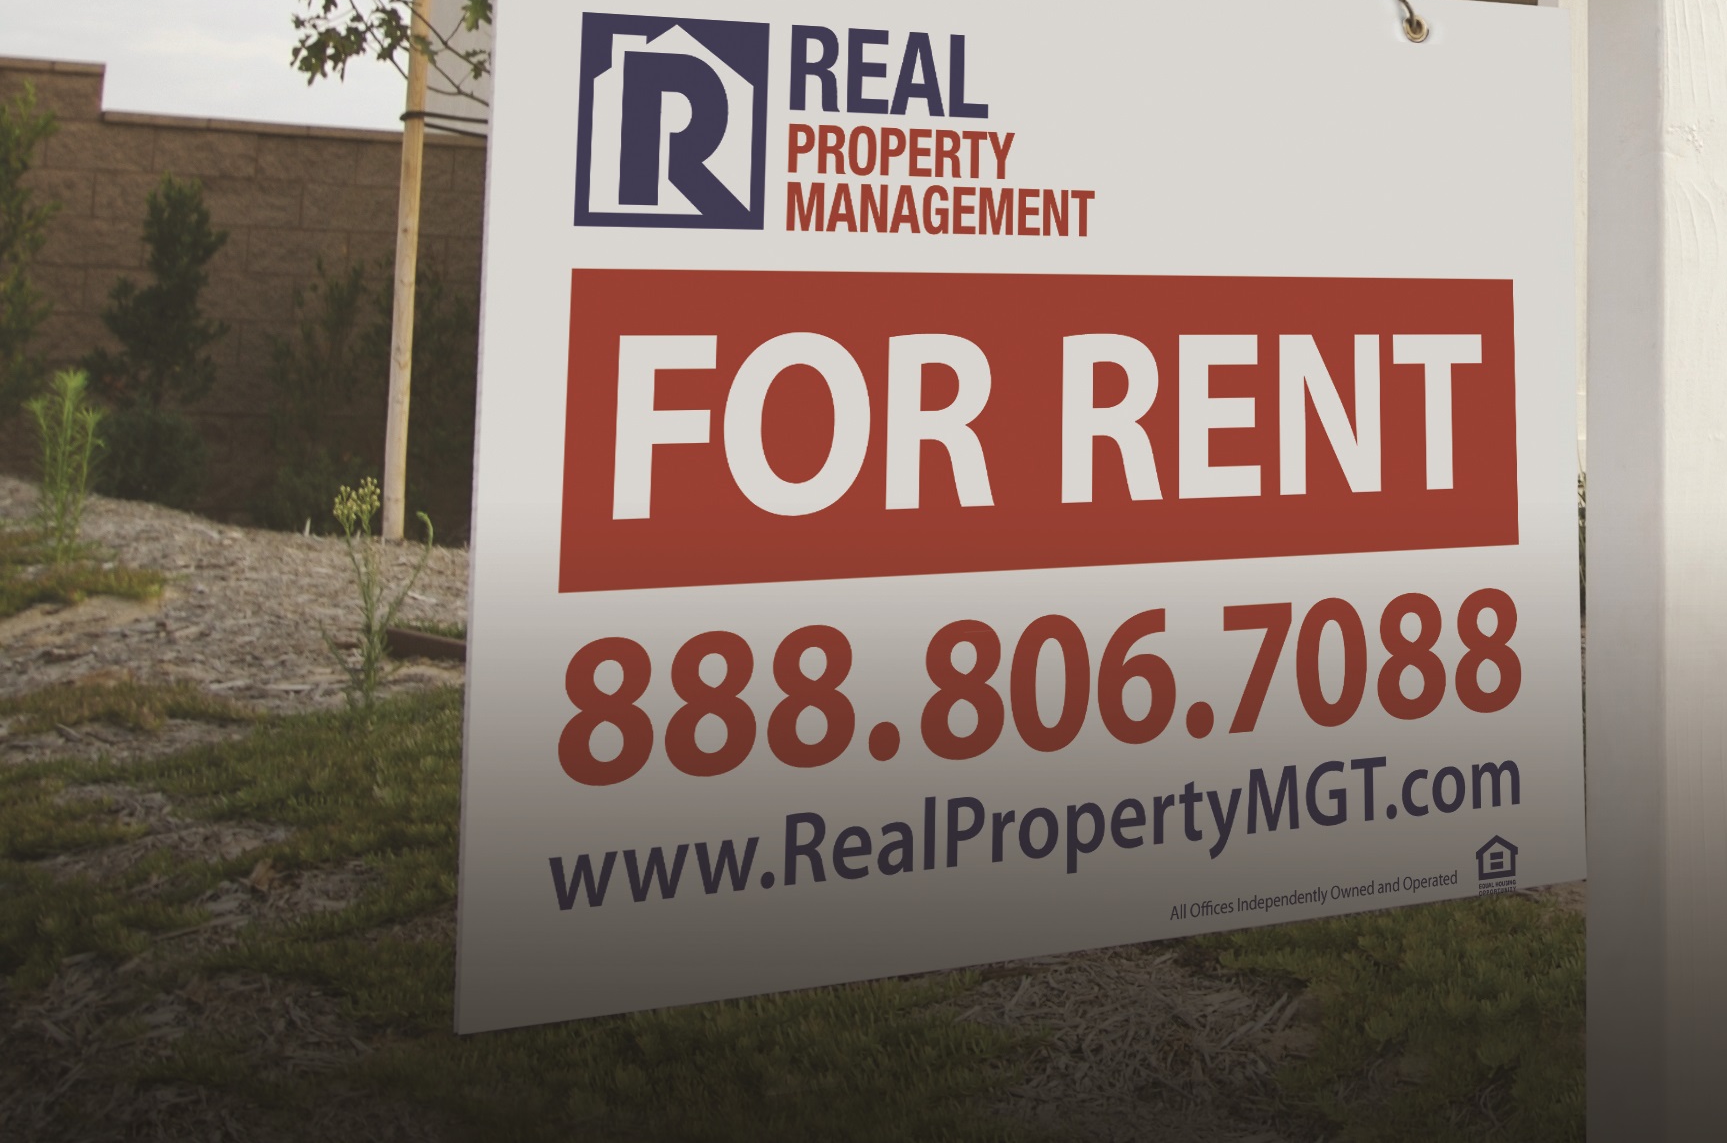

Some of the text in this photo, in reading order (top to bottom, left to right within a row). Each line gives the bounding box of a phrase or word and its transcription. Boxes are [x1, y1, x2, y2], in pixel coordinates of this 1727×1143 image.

[789, 25, 989, 119] REAL
[786, 124, 1015, 179] PROPERTY
[786, 182, 1095, 237] MANAGEMENT
[613, 332, 1482, 520] FOR RENT
[558, 588, 1522, 787] 888.806.7088
[549, 757, 1521, 911] www.RealPropertyMGT.com
[1169, 870, 1458, 920] All Offices Independently Owned and Operated
